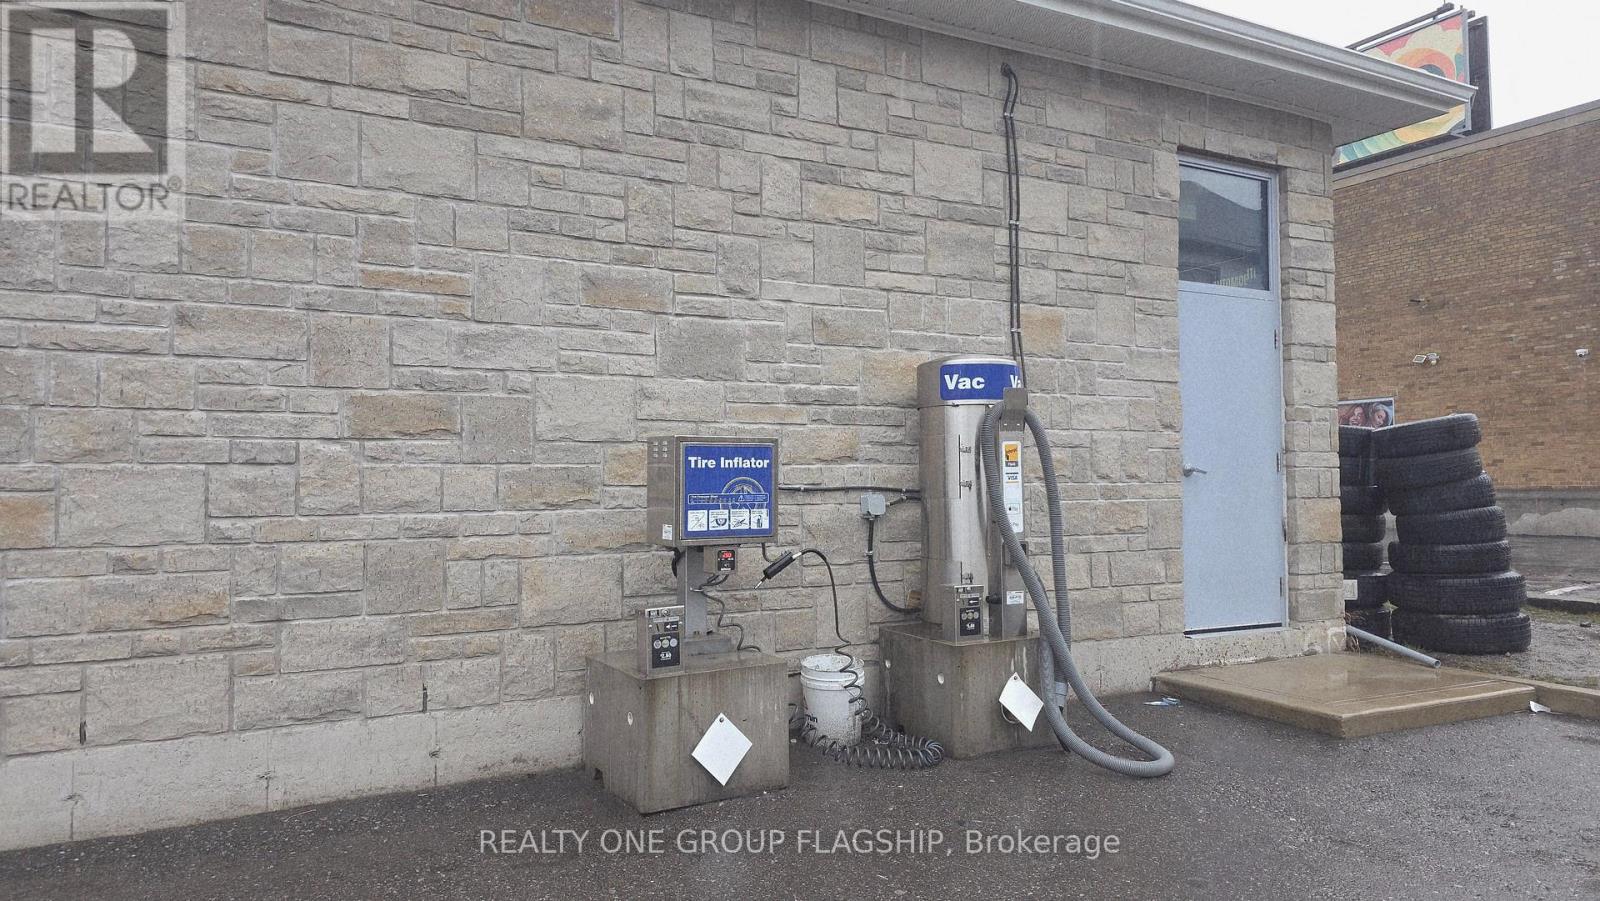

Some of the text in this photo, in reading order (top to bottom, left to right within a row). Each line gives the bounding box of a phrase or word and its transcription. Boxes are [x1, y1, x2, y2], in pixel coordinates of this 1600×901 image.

[943, 374, 985, 390] Vac
[688, 456, 769, 469] Tire Inflator
